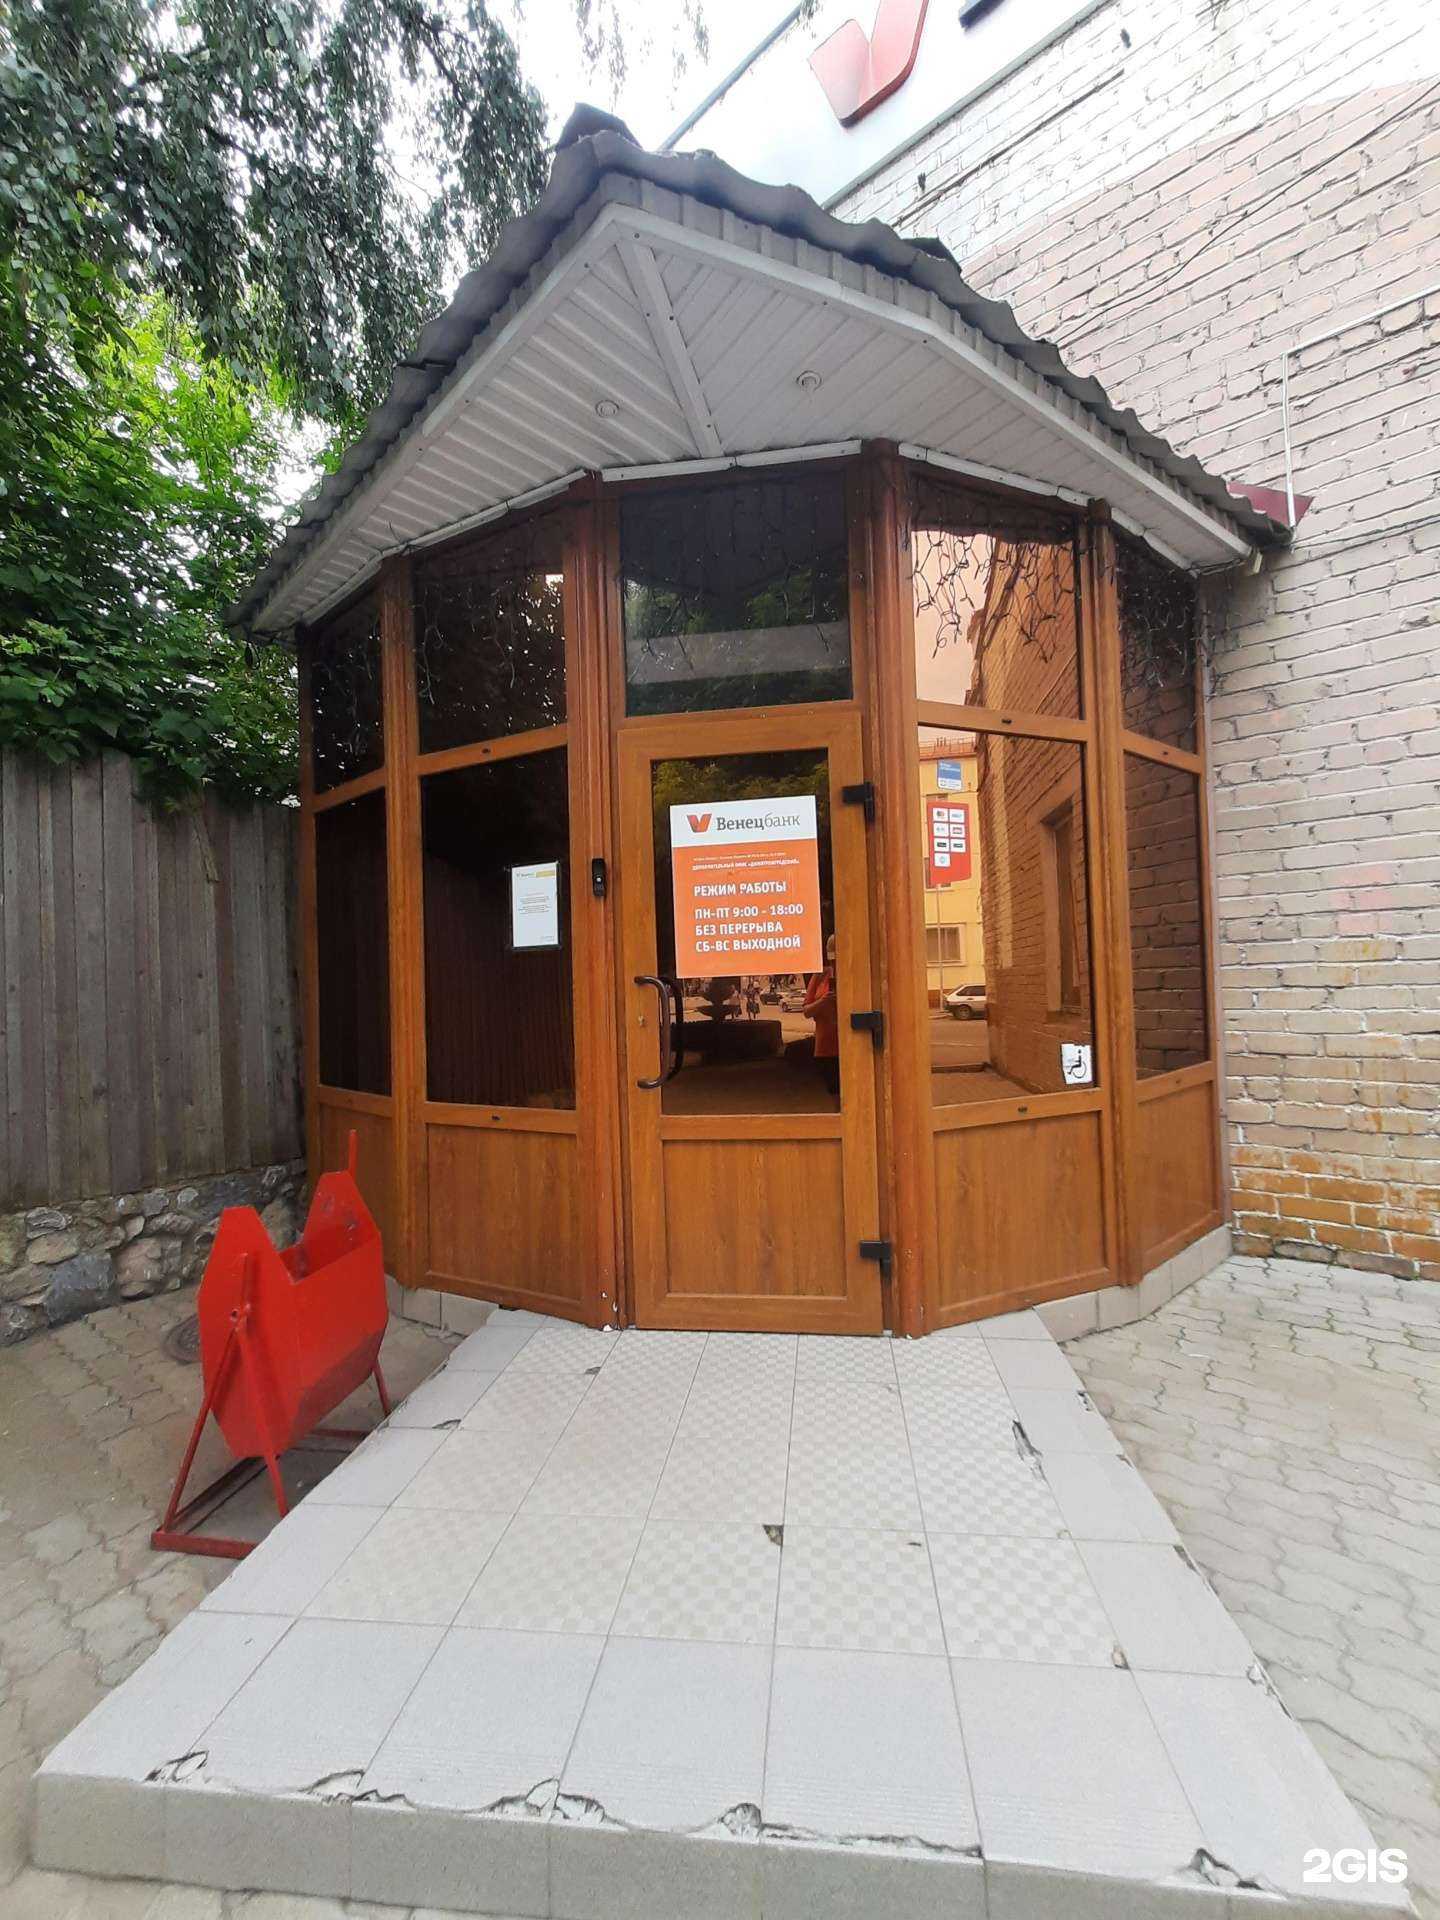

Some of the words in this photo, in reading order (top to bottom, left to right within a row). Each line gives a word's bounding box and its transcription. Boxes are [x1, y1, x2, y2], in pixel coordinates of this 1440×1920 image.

[716, 813, 800, 831] Венецбанк
[694, 883, 736, 897] РЕЖИМ
[740, 881, 787, 895] РАБОТЫ
[695, 907, 730, 920] ПН-ПТ
[732, 906, 758, 918] 9:00
[770, 903, 804, 916] 18:00
[695, 924, 716, 936] БЕЗ
[720, 921, 783, 935] ПЕРЕРЫВА
[695, 940, 730, 953] СБ-ВС
[734, 934, 800, 951] ВЫХОДНОЙ
